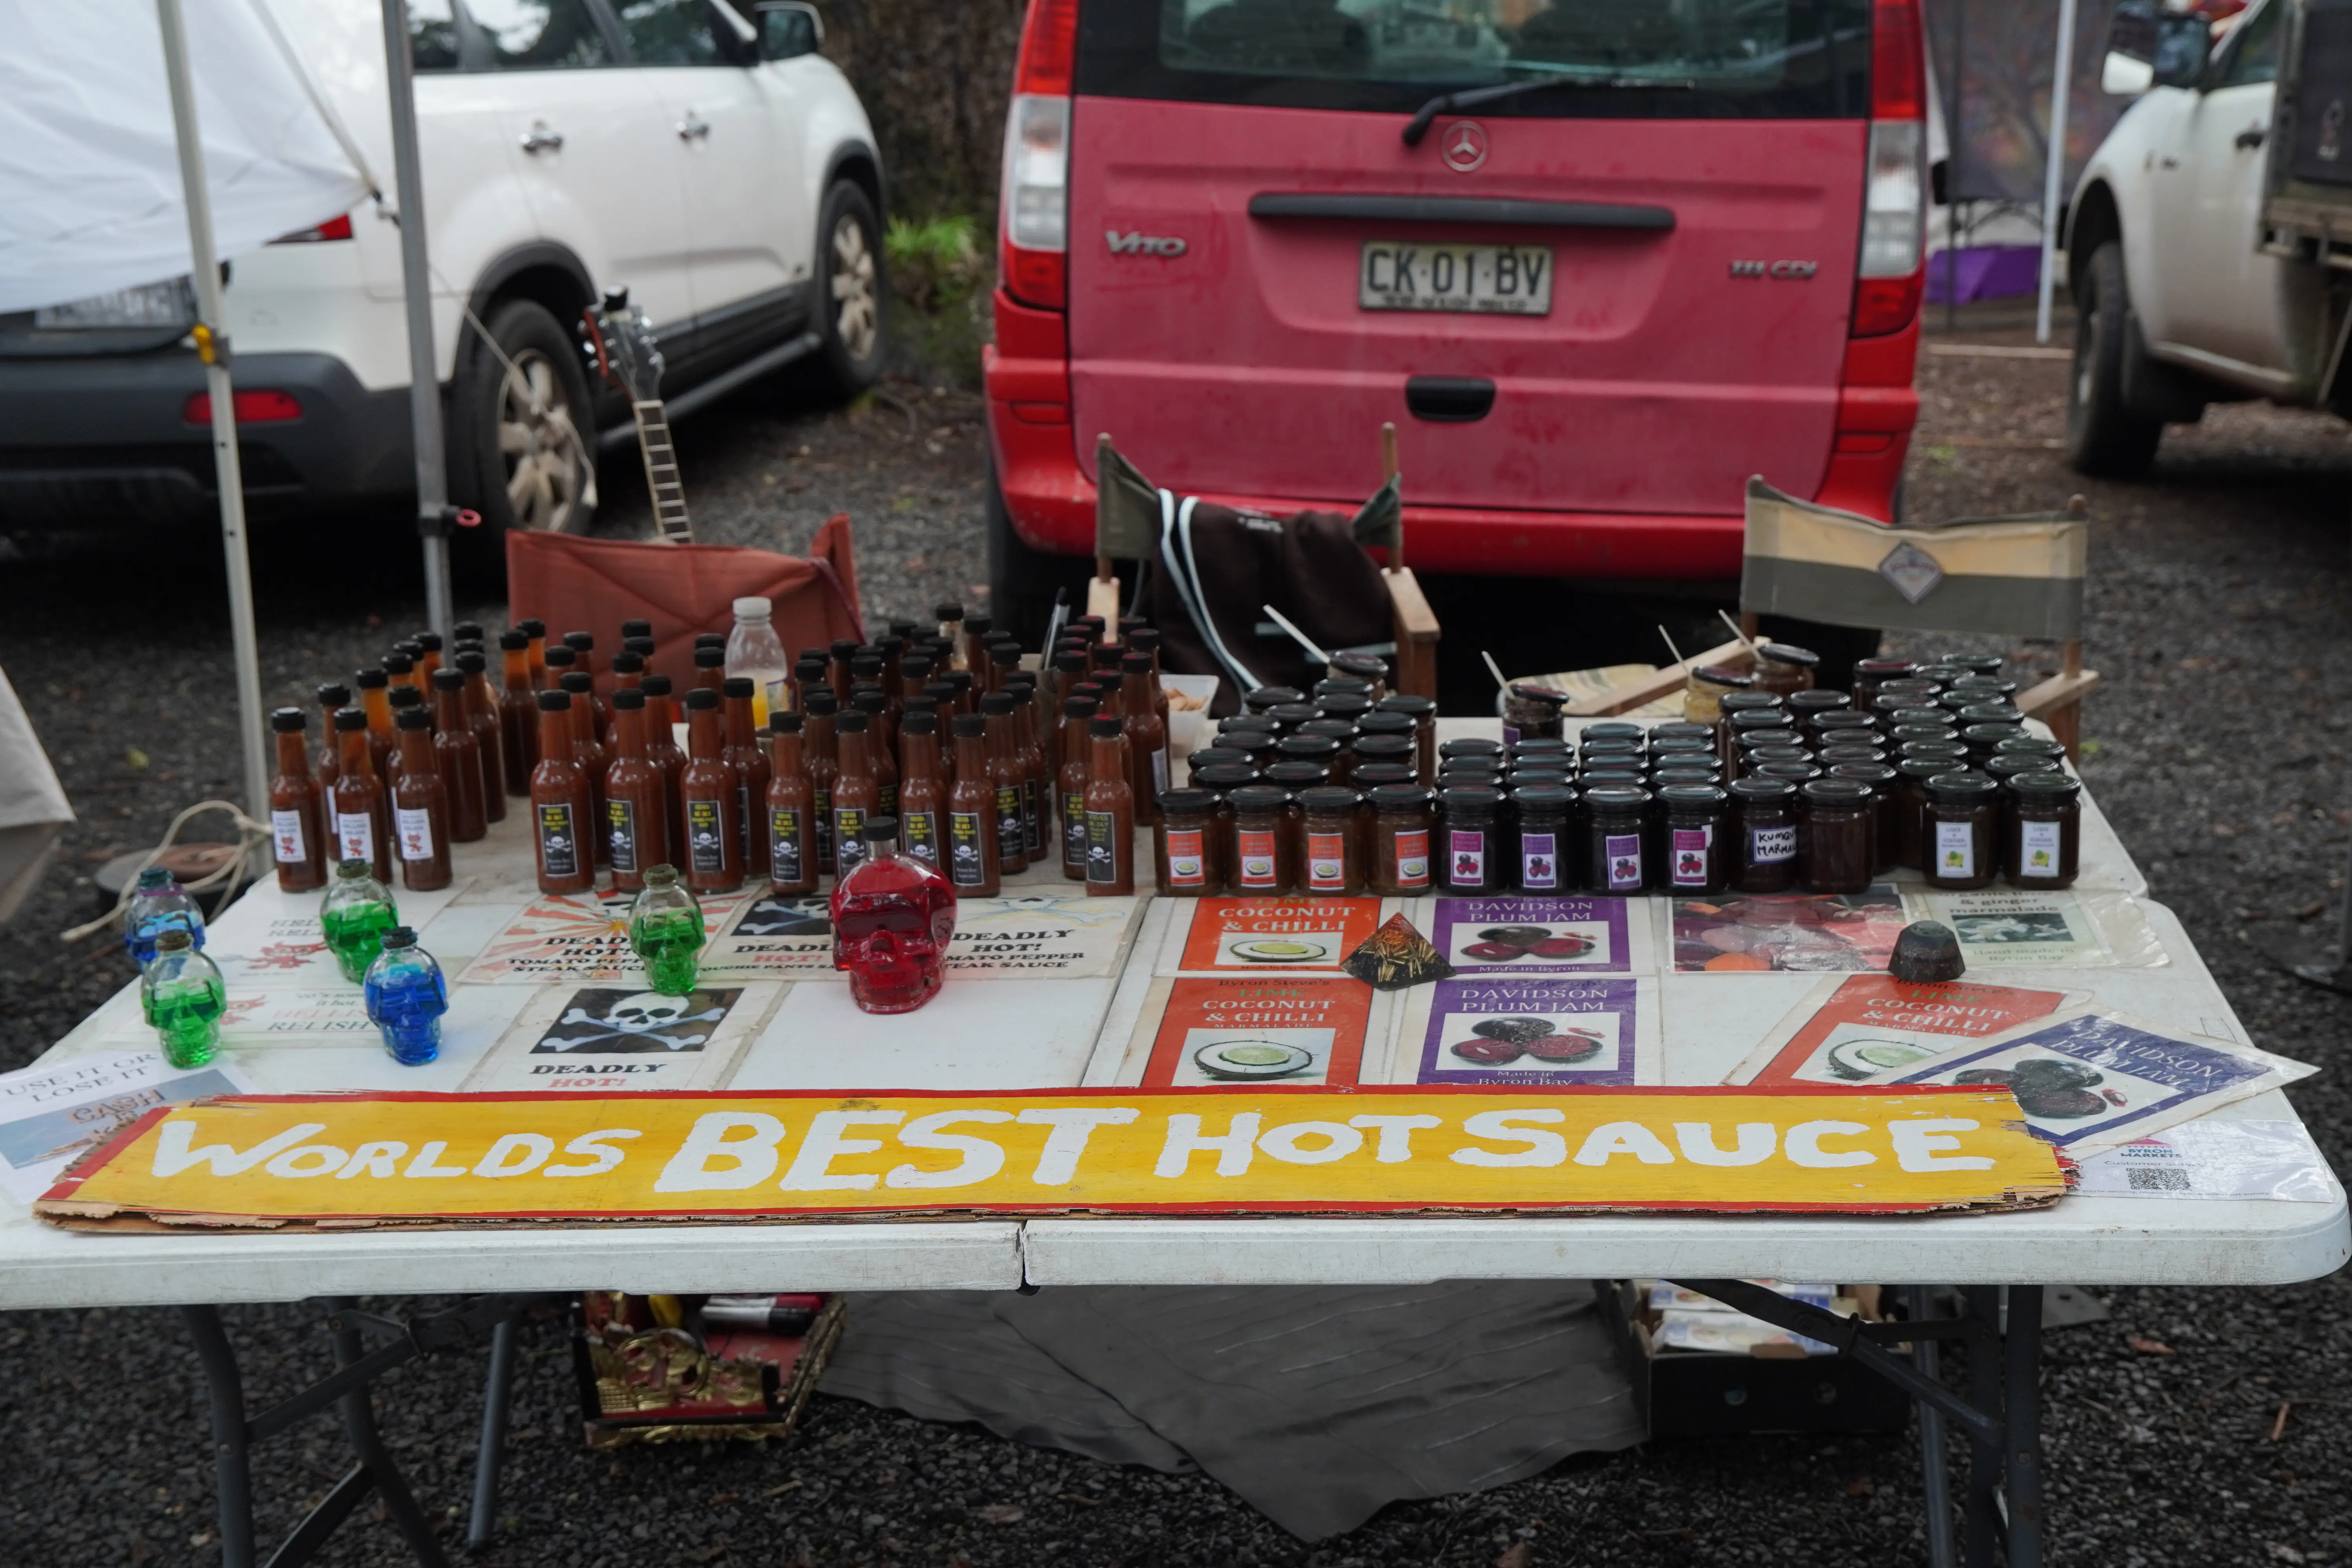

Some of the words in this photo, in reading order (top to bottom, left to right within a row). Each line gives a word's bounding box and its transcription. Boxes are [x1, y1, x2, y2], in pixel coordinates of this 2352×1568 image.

[1770, 259, 1819, 279] CDI
[1758, 830, 1794, 842] KUMQU
[1218, 907, 1356, 917] COCONUT
[1468, 902, 1593, 911] DAVIDSON
[1470, 913, 1536, 922] PLUM
[1545, 912, 1591, 922] JAM
[1221, 921, 1244, 931] &
[1252, 921, 1346, 931] CHILLI
[544, 936, 630, 945] DEAD
[951, 929, 1075, 941] DEADLY
[733, 944, 833, 953] DEADL
[971, 943, 1042, 952] HOT!
[1008, 952, 1085, 960] PEPPER
[1239, 989, 1306, 997] LIME
[1461, 989, 1608, 998] DAVIDSON
[1911, 989, 1985, 1004] LIME
[1202, 1000, 1336, 1009] COCONUT
[1462, 1002, 1540, 1012] PLUM
[1551, 1002, 1605, 1013] JAM
[1866, 998, 2010, 1020] COCONUT
[1205, 1013, 1225, 1022] &
[1234, 1013, 1325, 1022] CHILLI
[1862, 1010, 1884, 1020] &
[1893, 1013, 1991, 1032] CHILLI
[267, 1020, 369, 1031] RELISH
[1867, 1020, 1971, 1037] MARMALADE
[2074, 1029, 2224, 1078] DAVIDSON
[529, 1063, 668, 1074] DEADLY
[5, 1074, 67, 1096] USE
[76, 1065, 104, 1080] IT
[112, 1053, 159, 1069] OR
[2126, 1065, 2191, 1087] JAM
[32, 1075, 117, 1103] LOSE
[120, 1065, 149, 1080] IT
[547, 1078, 627, 1088] HOT!
[67, 1088, 166, 1124] CASH
[151, 1120, 642, 1180] WORLDS
[653, 1107, 1141, 1193] BEST
[1152, 1108, 1443, 1179] HOT
[1447, 1108, 1996, 1173] SAUCE
